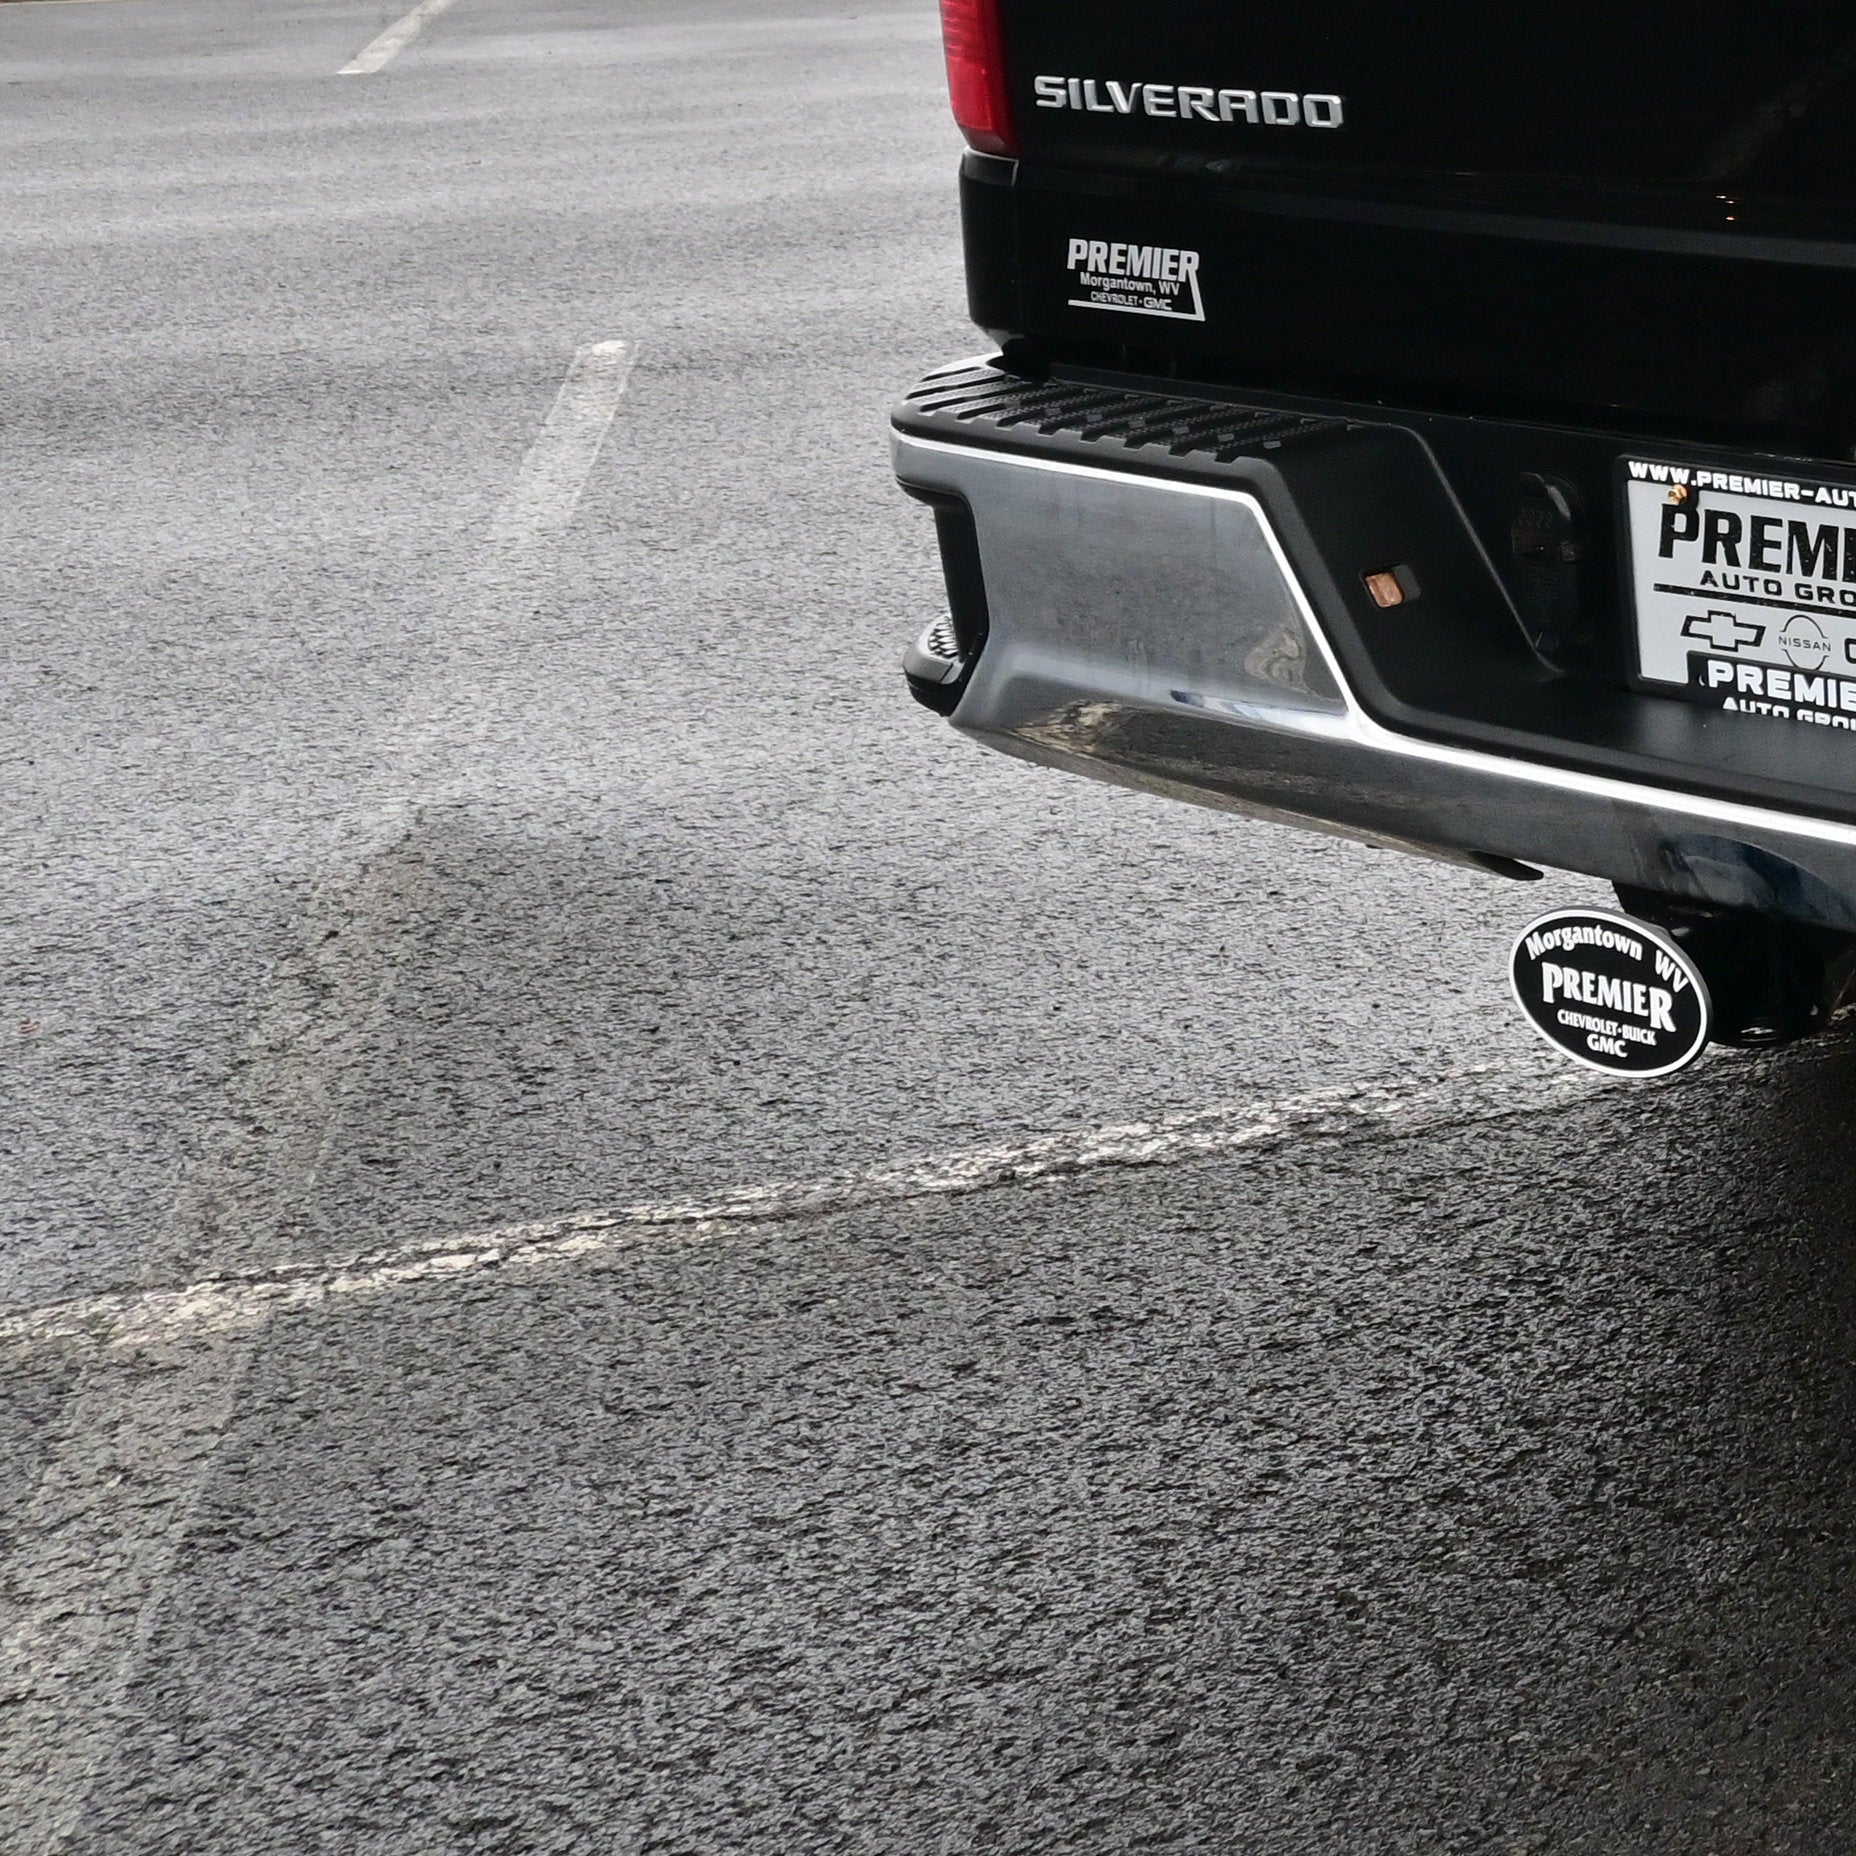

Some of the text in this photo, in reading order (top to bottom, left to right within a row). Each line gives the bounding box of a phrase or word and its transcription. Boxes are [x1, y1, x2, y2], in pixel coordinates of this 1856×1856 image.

[1034, 75, 1343, 128] SILVERADO
[1067, 238, 1200, 283] PREMIER
[1080, 272, 1180, 296] Morgantown, WV
[1143, 297, 1172, 311] GMC
[1699, 570, 1782, 597] AUTO
[1778, 635, 1831, 653] NISSAN
[1722, 696, 1790, 719] AUTO
[1525, 924, 1689, 993] Morgantown WV
[1541, 961, 1677, 1033] PREMIER
[1586, 1033, 1628, 1058] GMC
